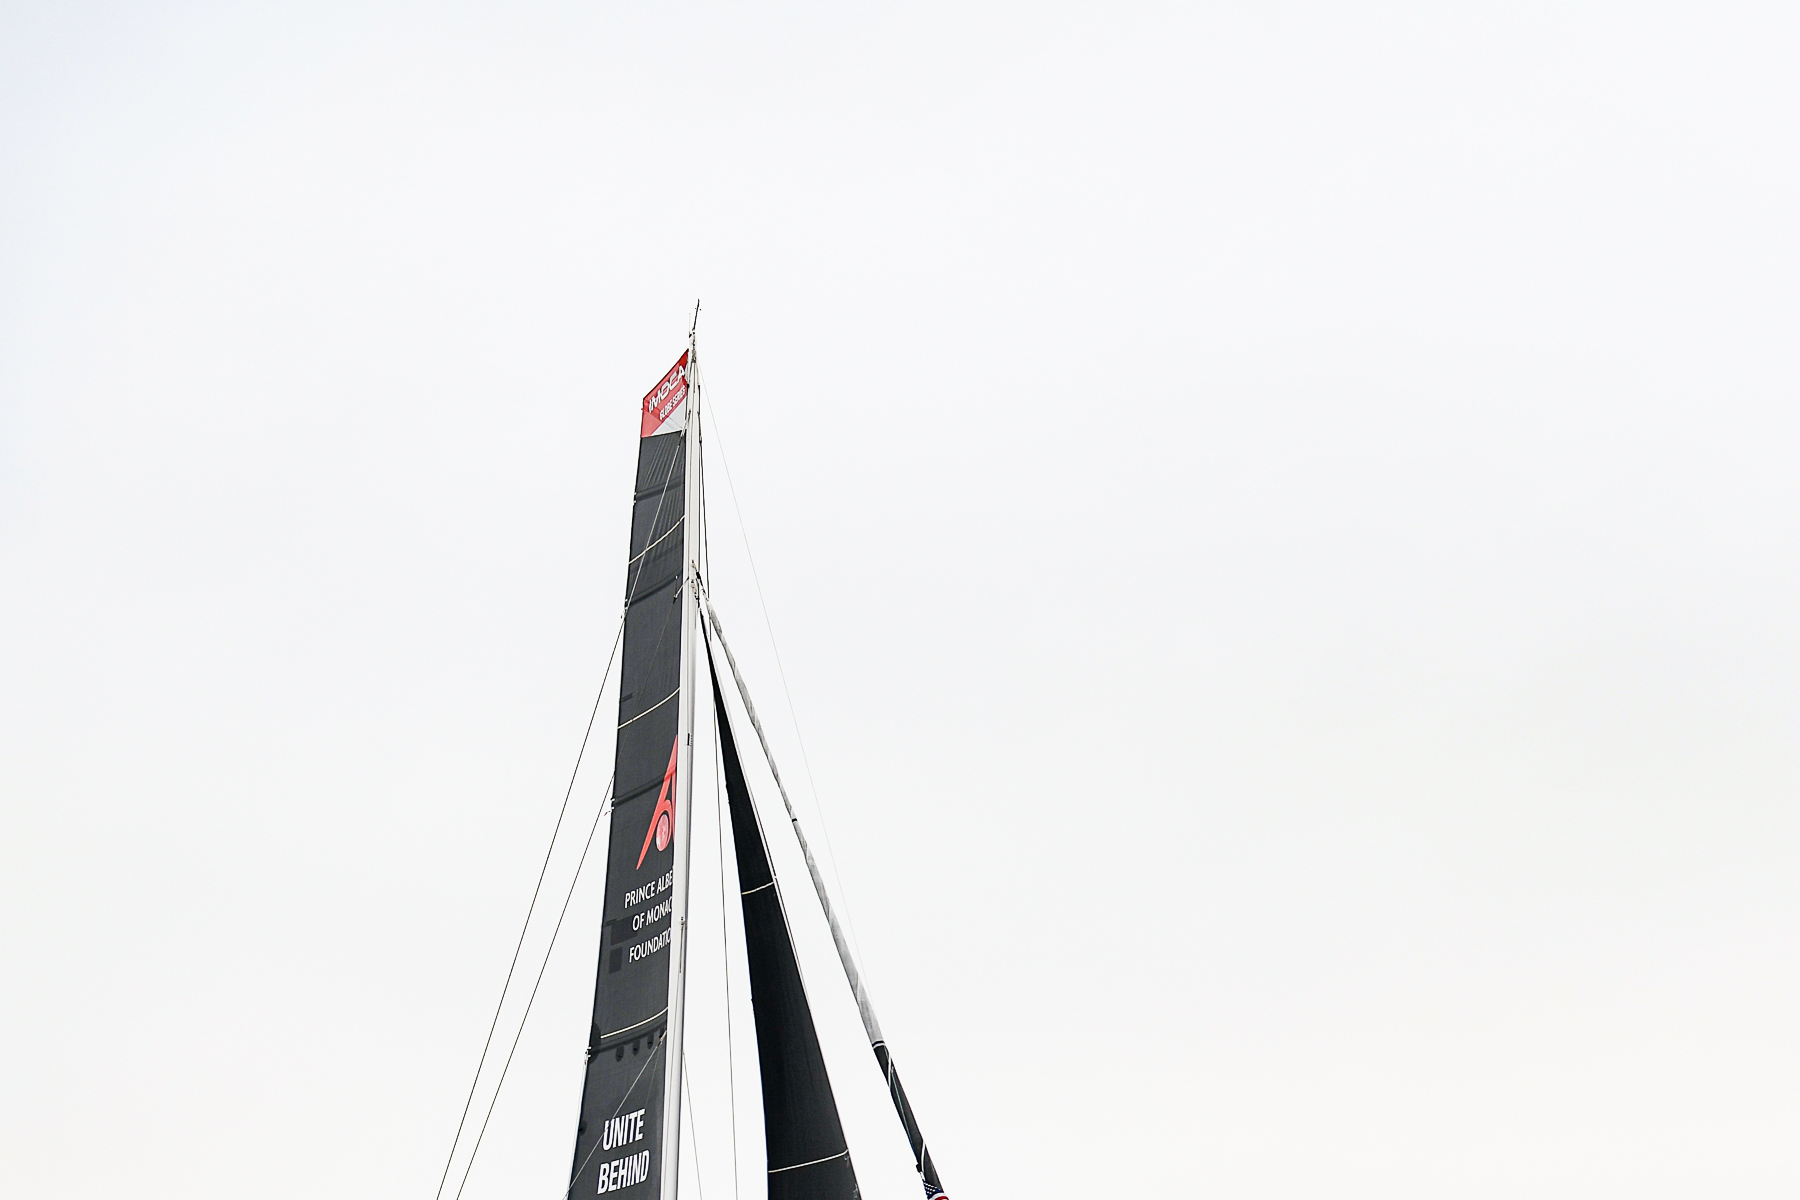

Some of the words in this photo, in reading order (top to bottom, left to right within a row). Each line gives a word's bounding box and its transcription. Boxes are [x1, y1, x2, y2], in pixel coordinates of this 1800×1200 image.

[624, 880, 656, 909] PRINCE
[632, 912, 645, 931] OF
[602, 1108, 645, 1151] UNITE
[597, 1150, 650, 1195] BEHIND
